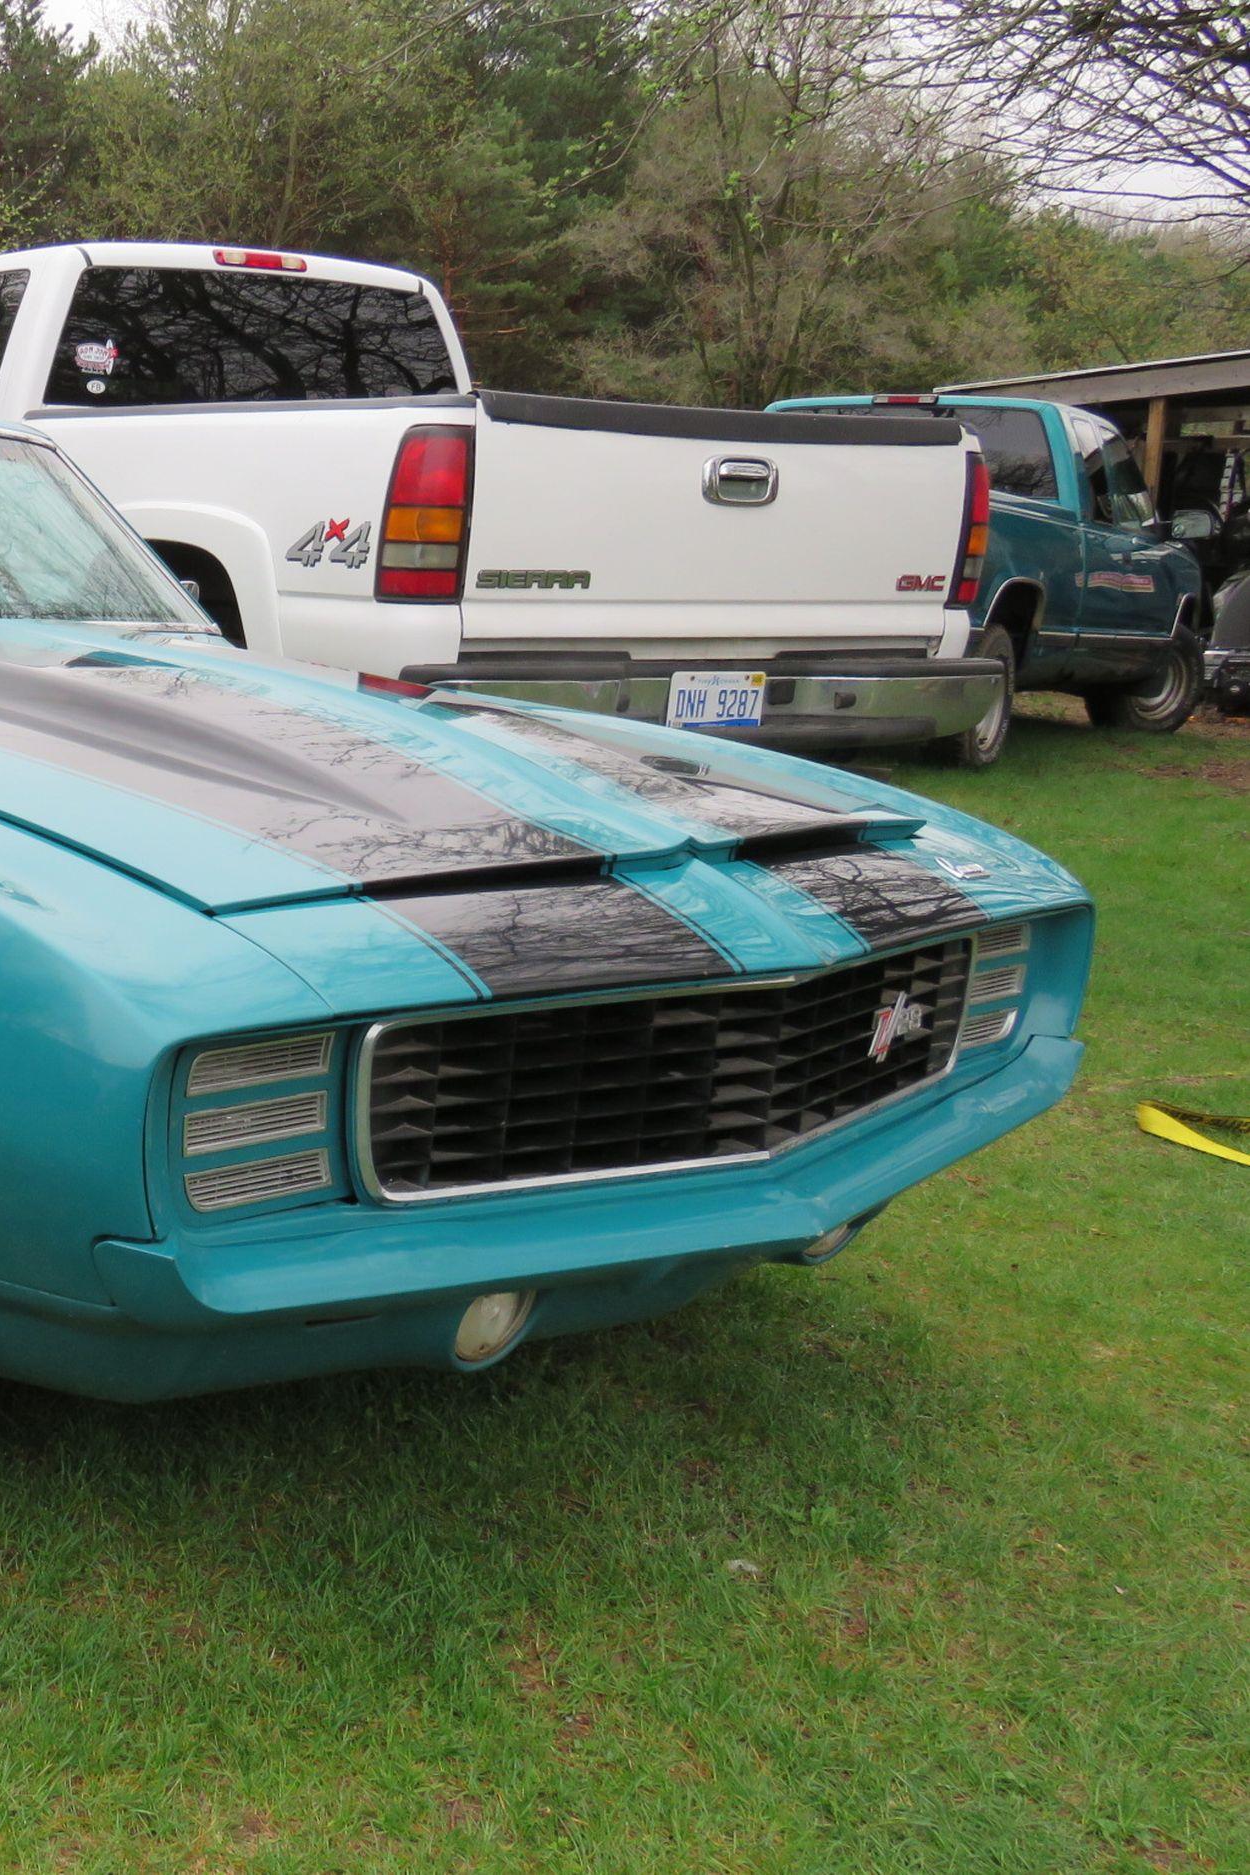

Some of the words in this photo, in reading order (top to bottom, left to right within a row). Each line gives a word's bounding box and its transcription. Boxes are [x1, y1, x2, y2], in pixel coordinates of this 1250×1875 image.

[475, 569, 591, 589] SIERRA
[895, 574, 946, 592] GMC
[675, 689, 707, 718] DNH
[717, 689, 759, 718] 9287
